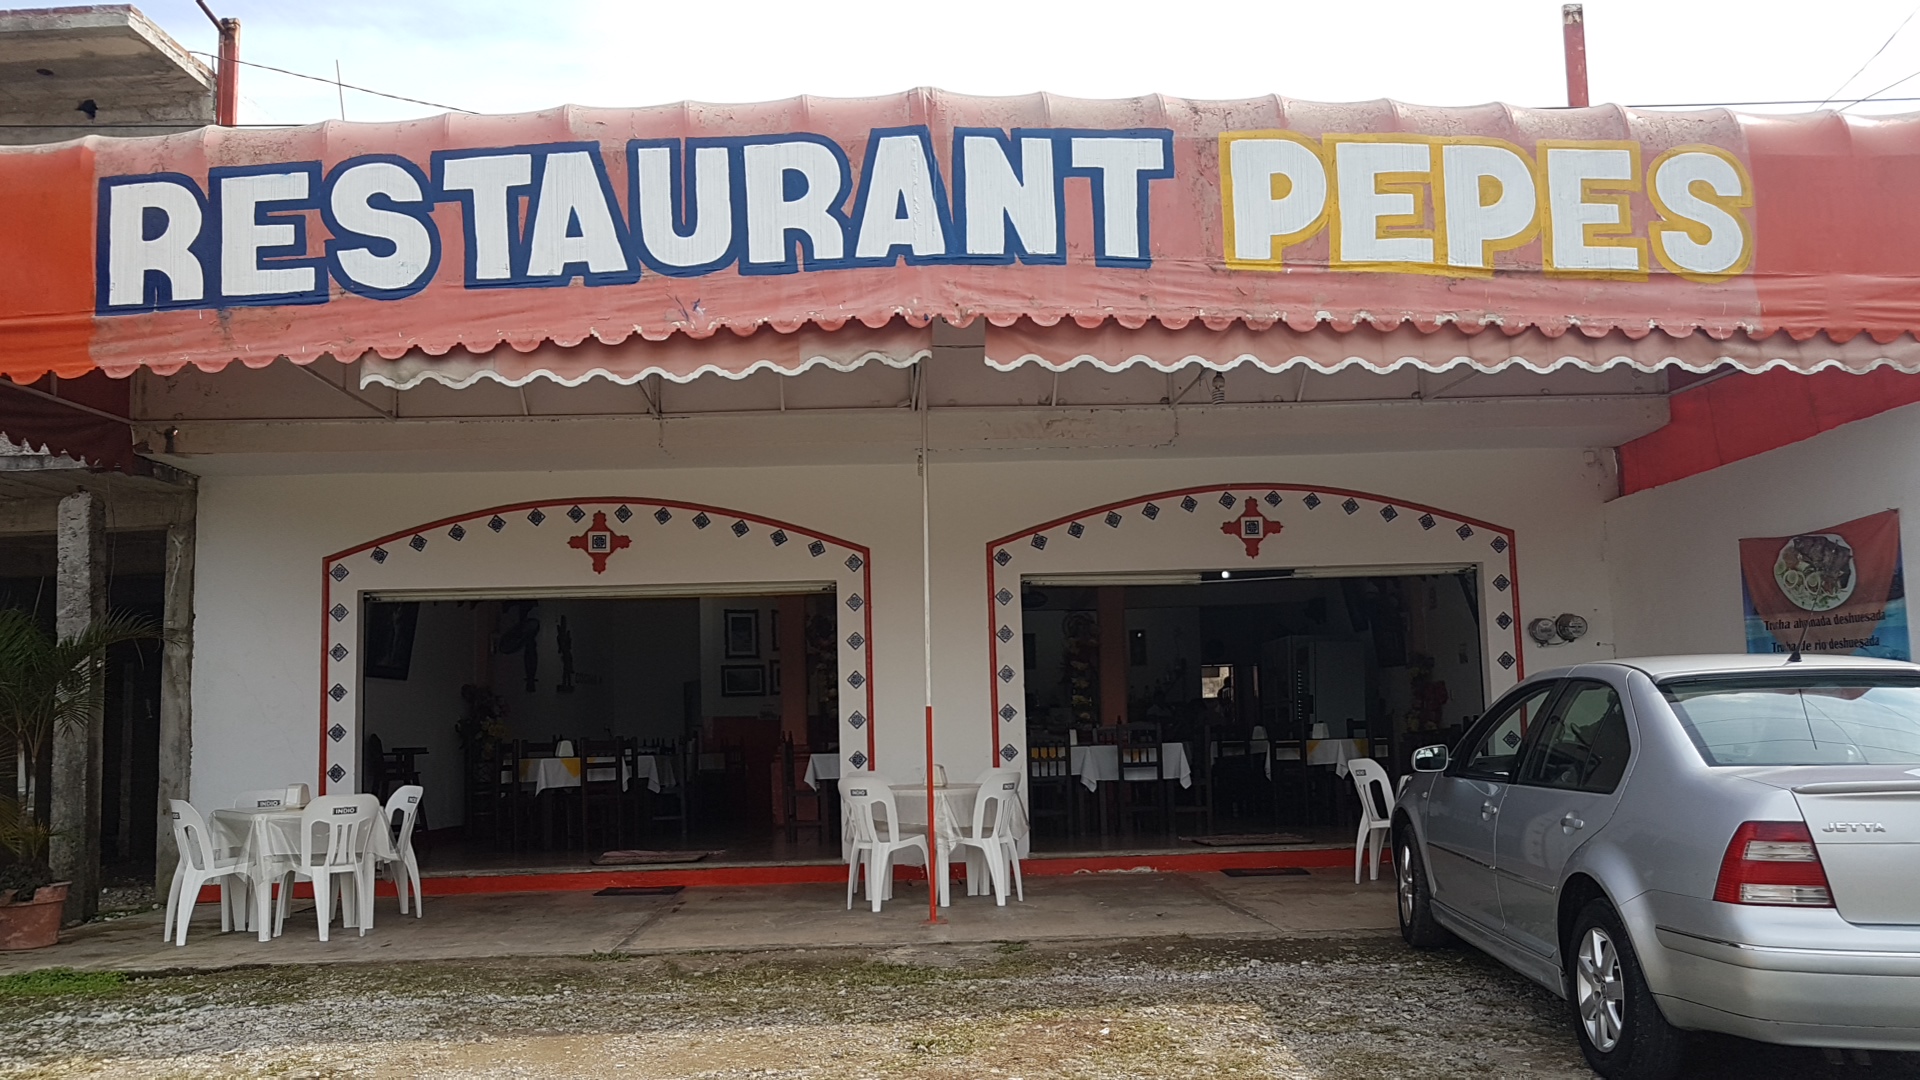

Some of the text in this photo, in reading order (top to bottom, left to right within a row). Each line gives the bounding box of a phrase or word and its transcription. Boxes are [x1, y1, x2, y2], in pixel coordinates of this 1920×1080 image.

[96, 125, 1754, 316] RESTAURANT PEPES
[1834, 609, 1886, 625] deshuesada
[1829, 635, 1880, 650] deshuesada
[1822, 822, 1886, 833] JETTA
